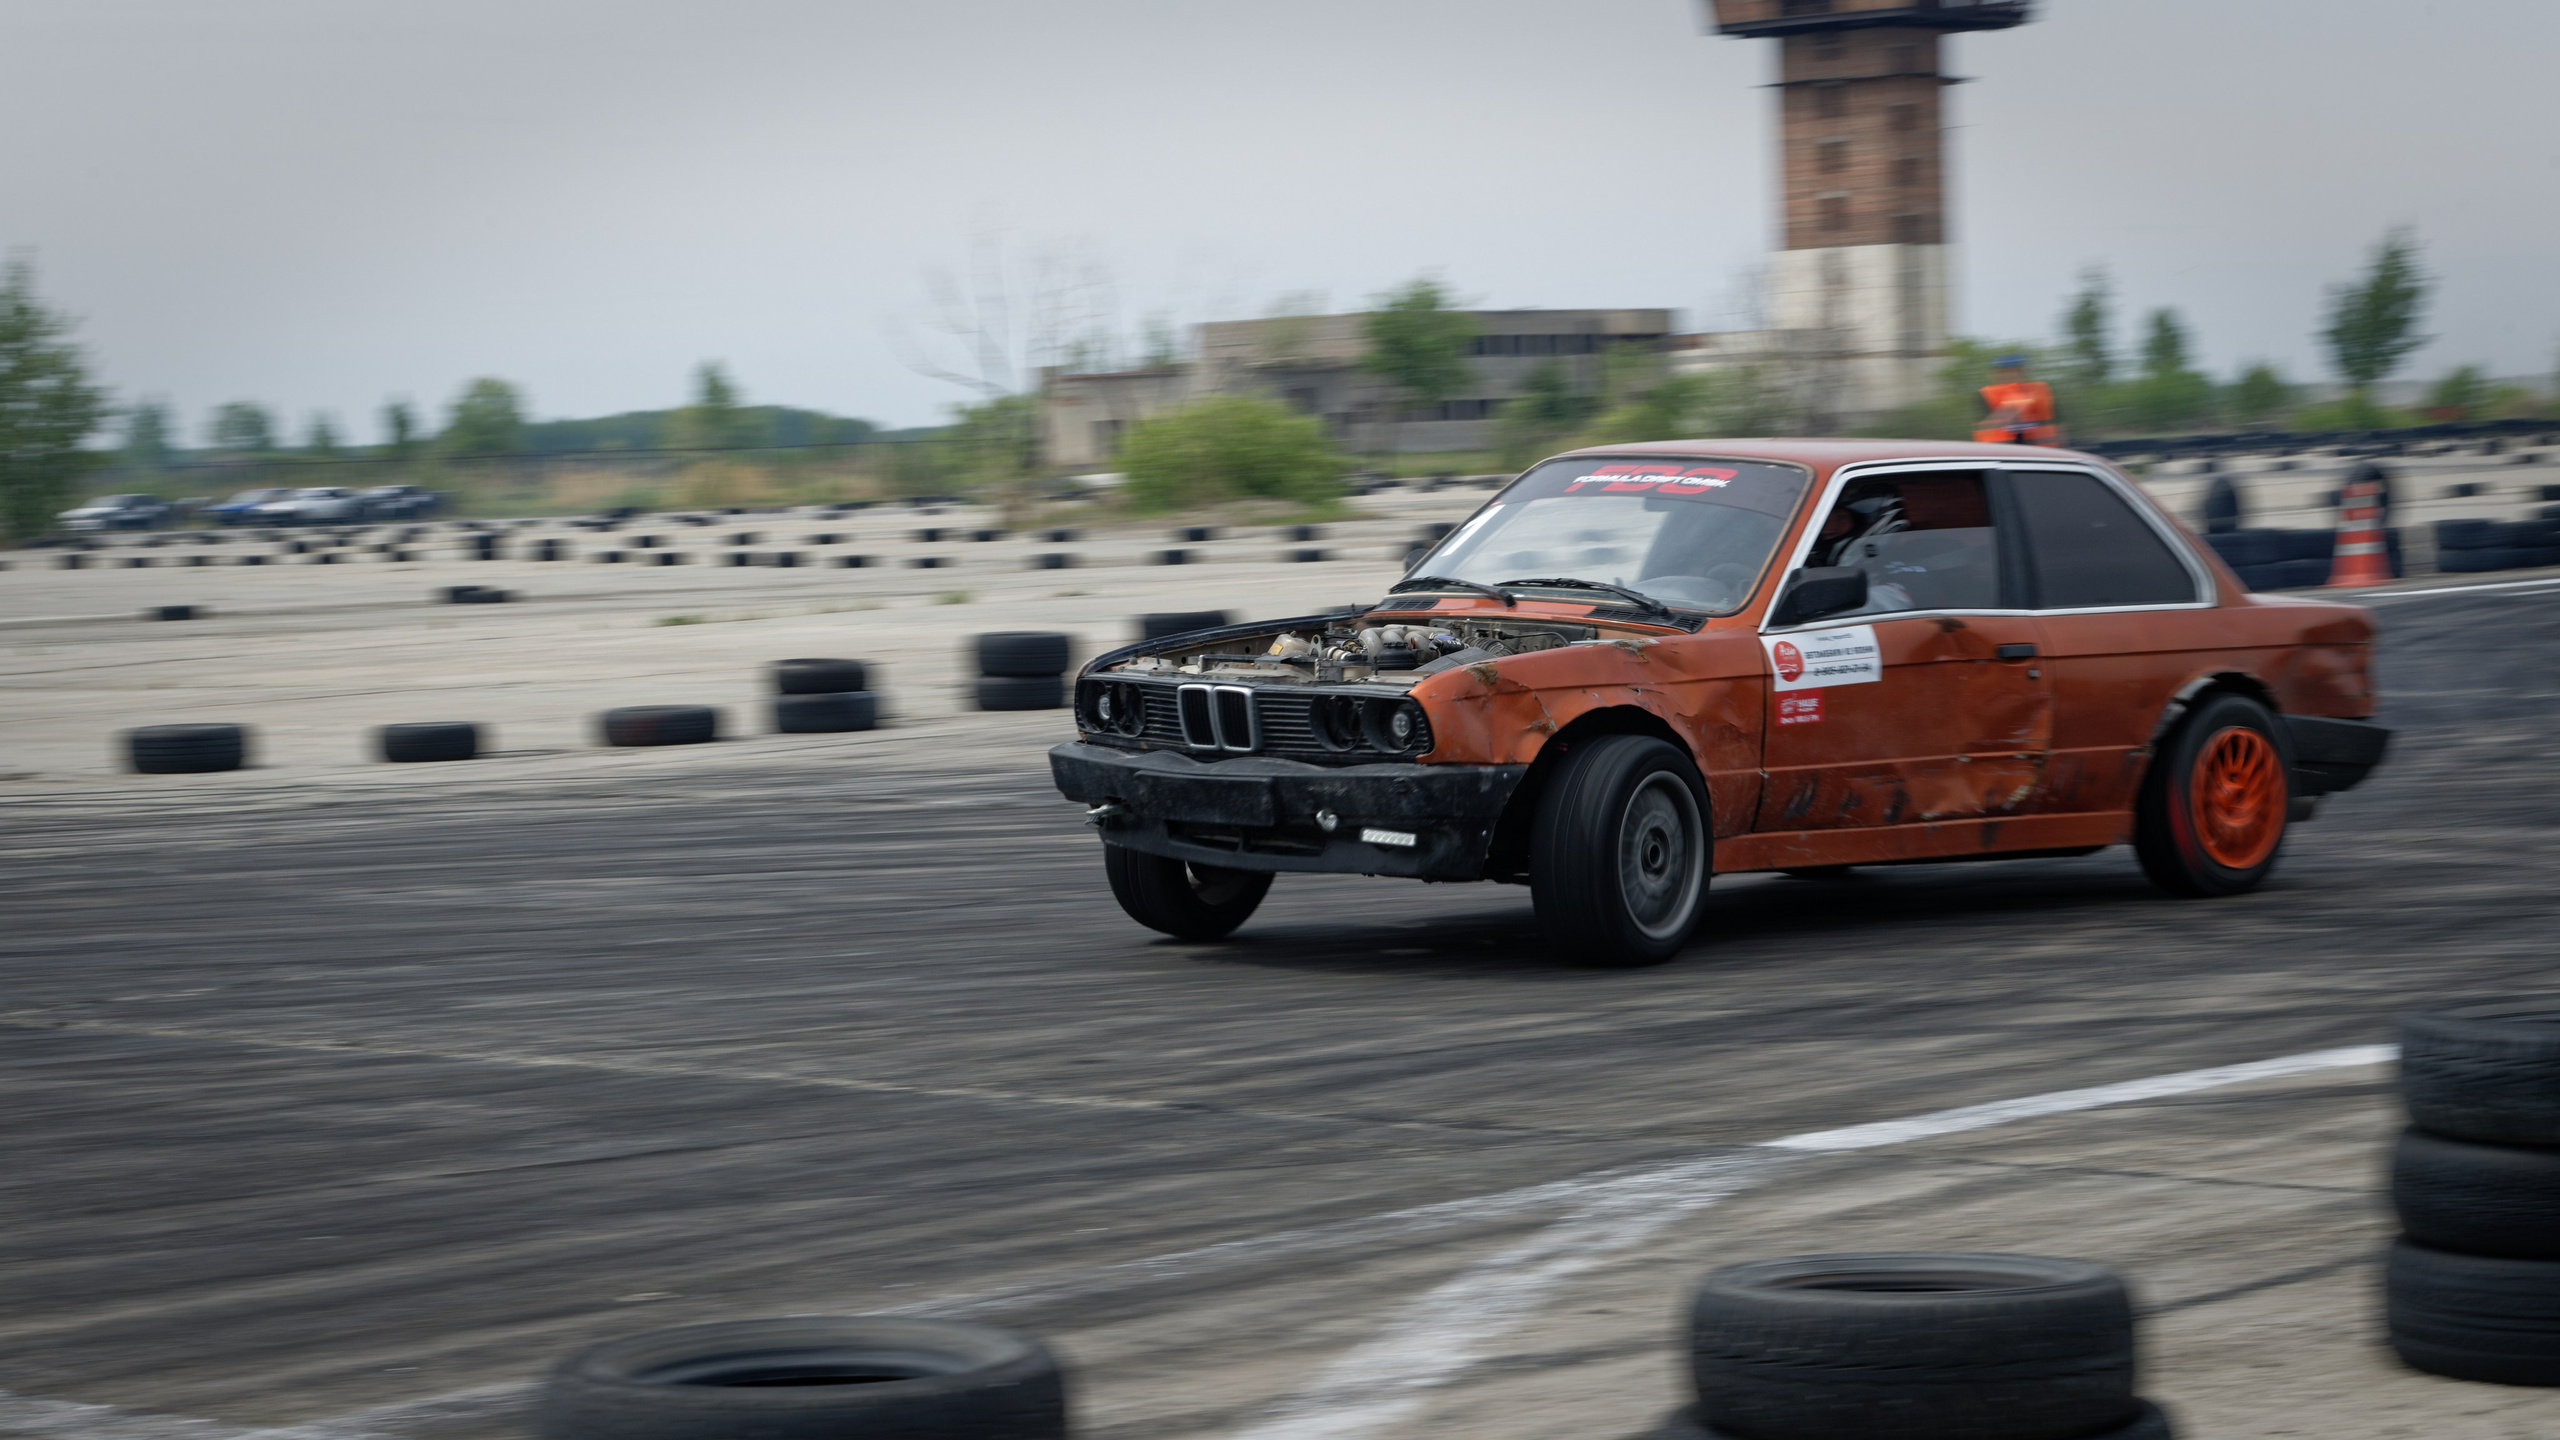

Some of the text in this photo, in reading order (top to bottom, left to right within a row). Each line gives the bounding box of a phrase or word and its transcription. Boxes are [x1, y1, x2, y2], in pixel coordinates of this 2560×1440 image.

[1572, 474, 1731, 487] FORMULA DRIFT OMSK
